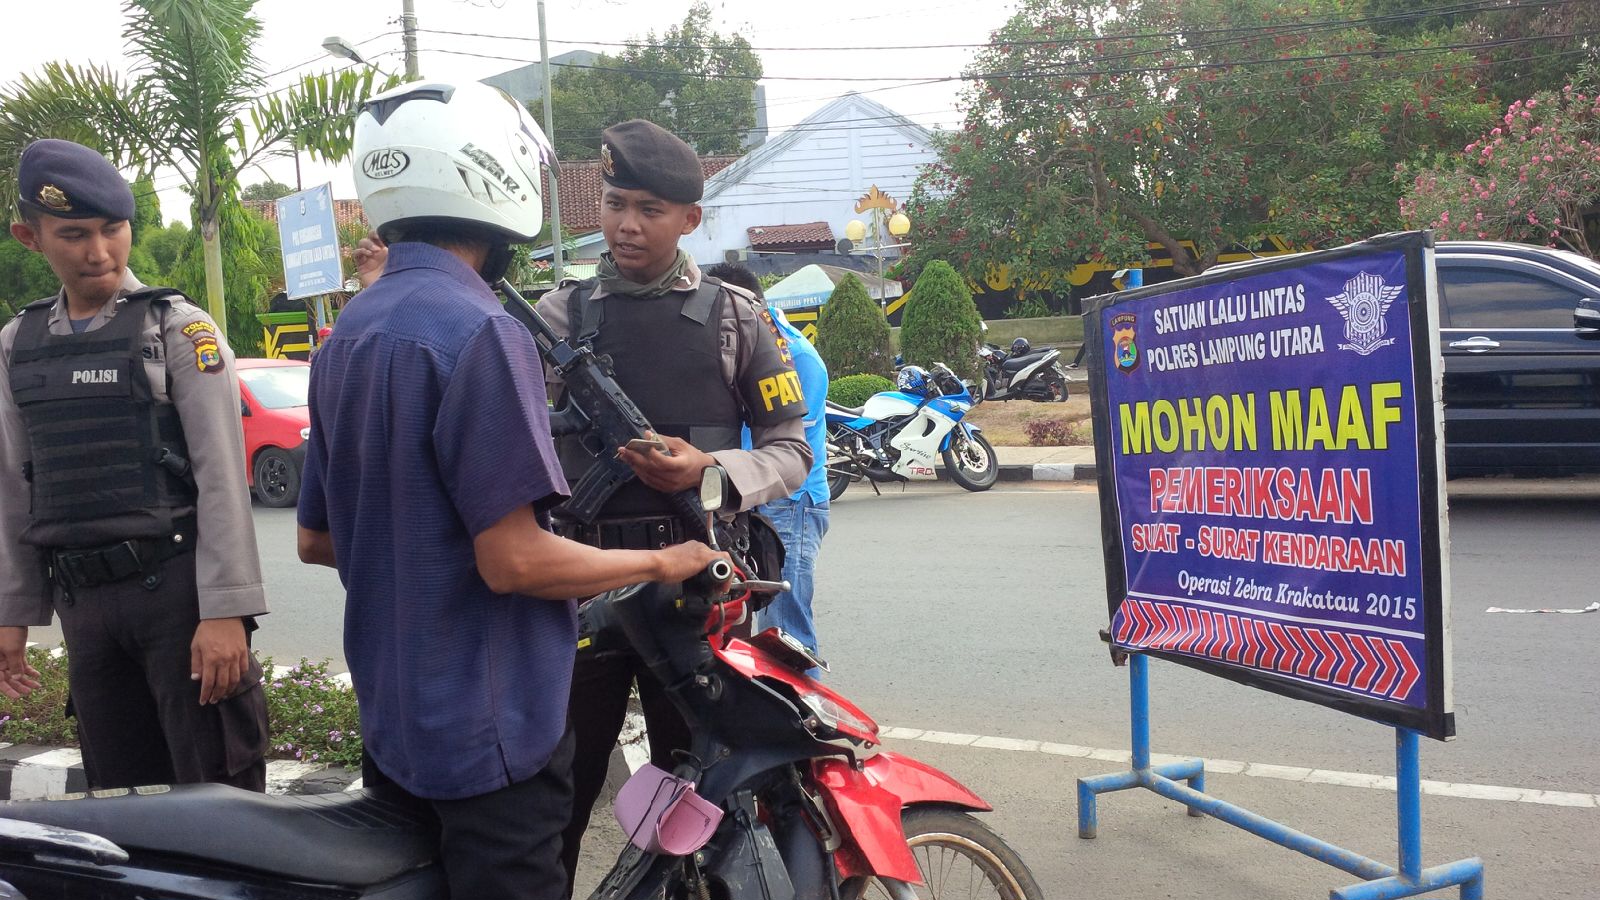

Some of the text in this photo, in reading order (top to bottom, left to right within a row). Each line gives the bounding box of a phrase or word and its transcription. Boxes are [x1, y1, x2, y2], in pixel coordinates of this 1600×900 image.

[1154, 284, 1305, 335] SATUAN LALU LINTAS
[1147, 342, 1199, 373] POLRES
[1199, 332, 1266, 367] LAMPUNG
[1269, 325, 1324, 358] UTARA
[72, 369, 118, 384] POLISI
[1119, 381, 1402, 455] MOHON MAAF
[1149, 467, 1374, 524] PEMERIKSAAN
[1198, 526, 1261, 562] SURAT
[1263, 531, 1407, 577] KENDARAAN
[1178, 569, 1416, 621] Operasi Zebra Krakatau 2015
